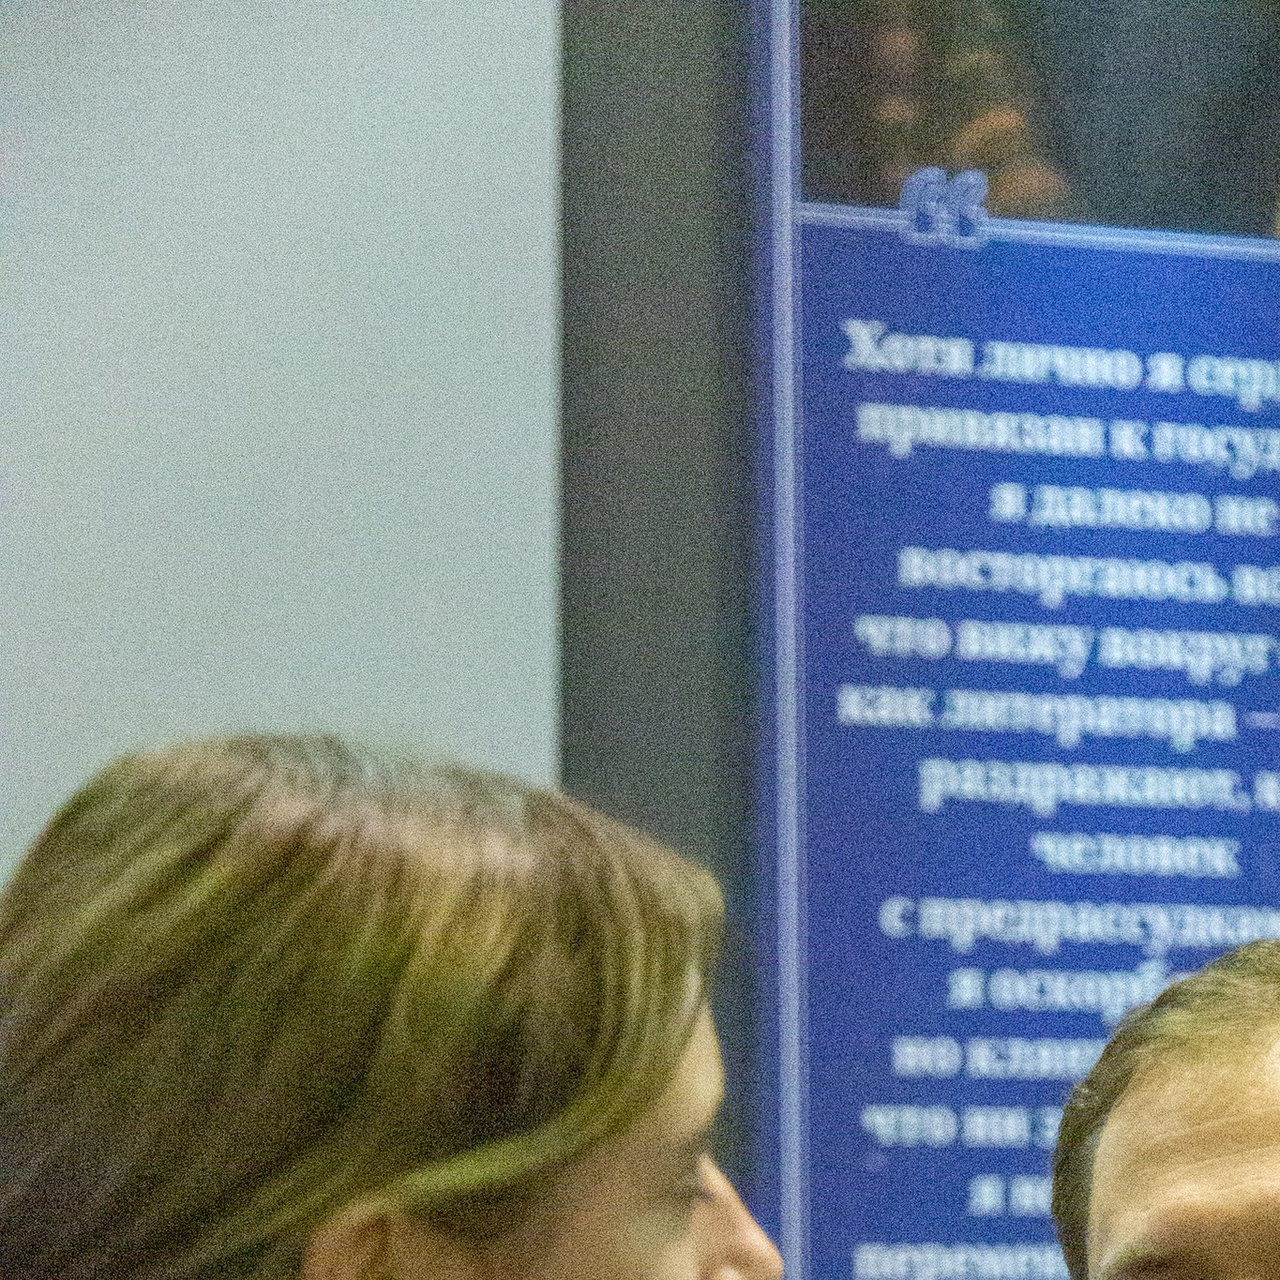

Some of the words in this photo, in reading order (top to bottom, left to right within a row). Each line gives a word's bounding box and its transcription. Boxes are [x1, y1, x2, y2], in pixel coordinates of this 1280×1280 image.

[1111, 421, 1145, 458] к
[992, 484, 1025, 520] я
[1030, 486, 1214, 531] далеко
[1212, 497, 1279, 535] не
[855, 616, 953, 657] что
[955, 620, 1093, 677] вижу
[1100, 628, 1275, 683] вокруг
[838, 686, 932, 726] как
[1031, 834, 1238, 876] человек
